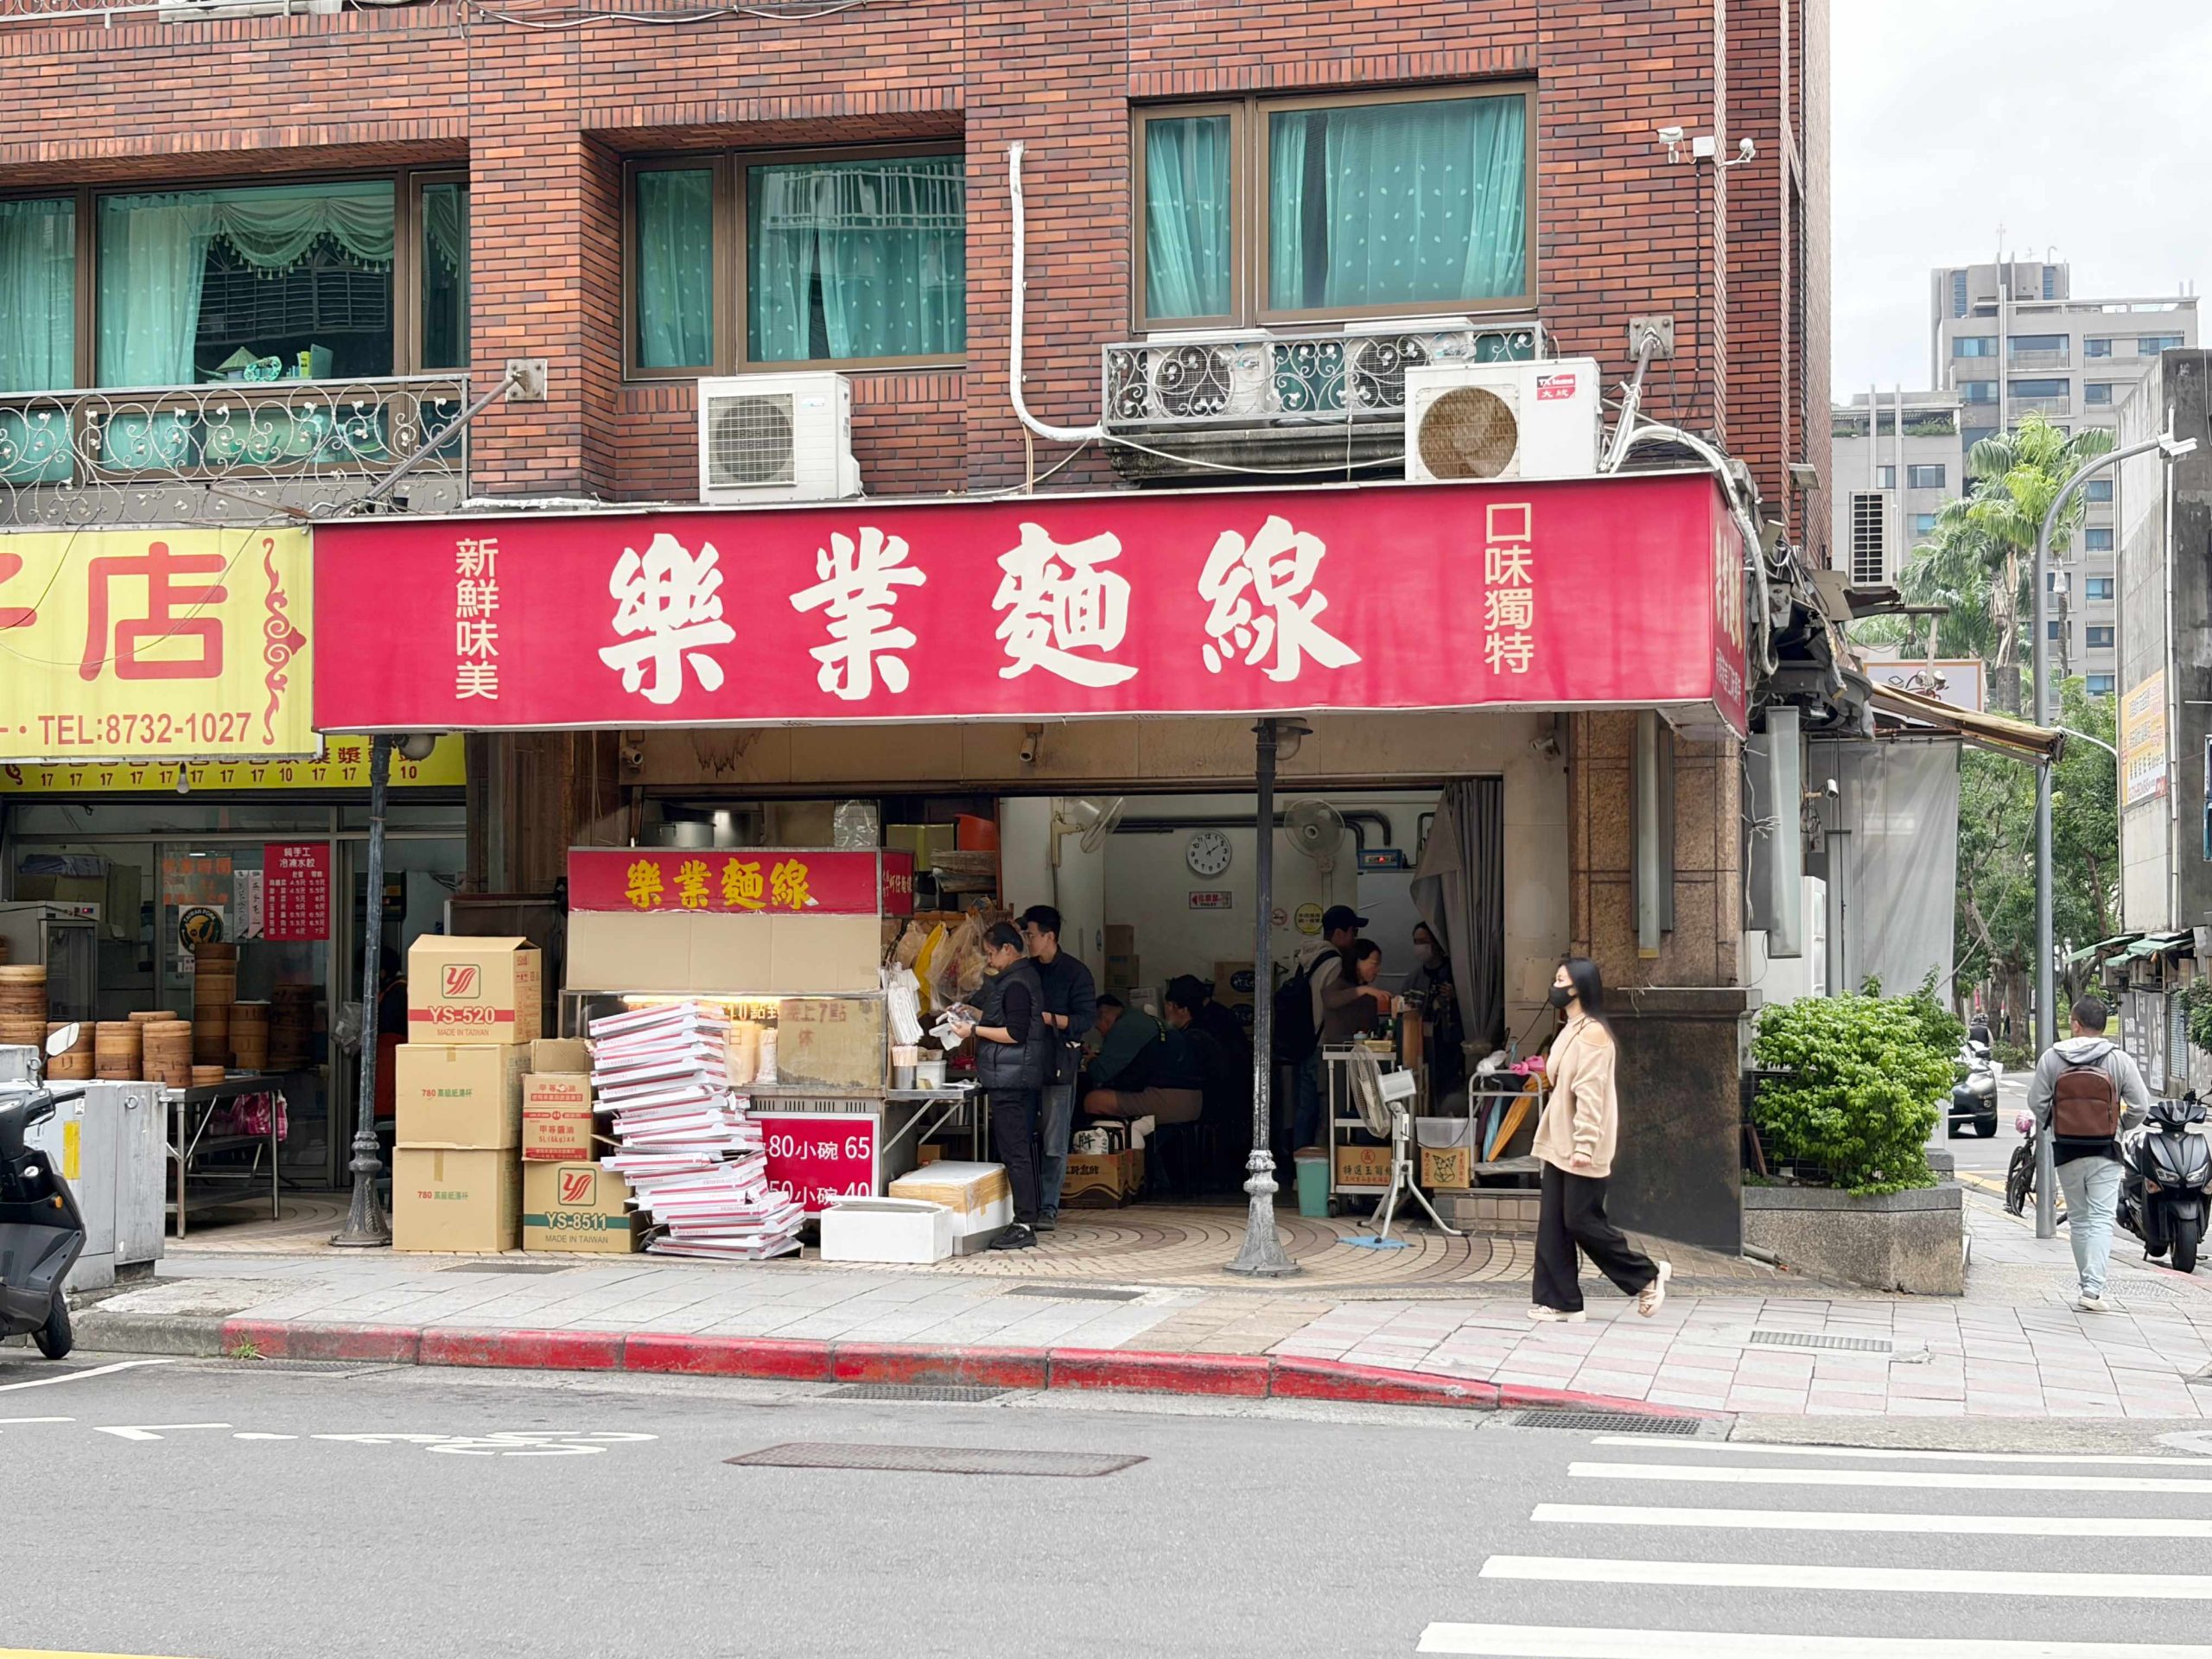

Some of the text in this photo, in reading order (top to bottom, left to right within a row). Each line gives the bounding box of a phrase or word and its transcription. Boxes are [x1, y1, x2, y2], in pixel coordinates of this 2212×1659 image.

[1484, 502, 1534, 675] 口味獨特
[455, 537, 499, 700] 新鮮味美
[598, 515, 1362, 705] 樂業麵線
[38, 713, 251, 746] TEL:8732-1027
[41, 766, 417, 786] 17 17 17 17 17 17 17 17 10 17 17 10
[625, 858, 819, 910] 樂業麵線
[428, 1005, 495, 1024] YS-520
[539, 1084, 576, 1092] 甲等油
[845, 1136, 870, 1160] 65
[545, 1211, 607, 1230] YS-8511
